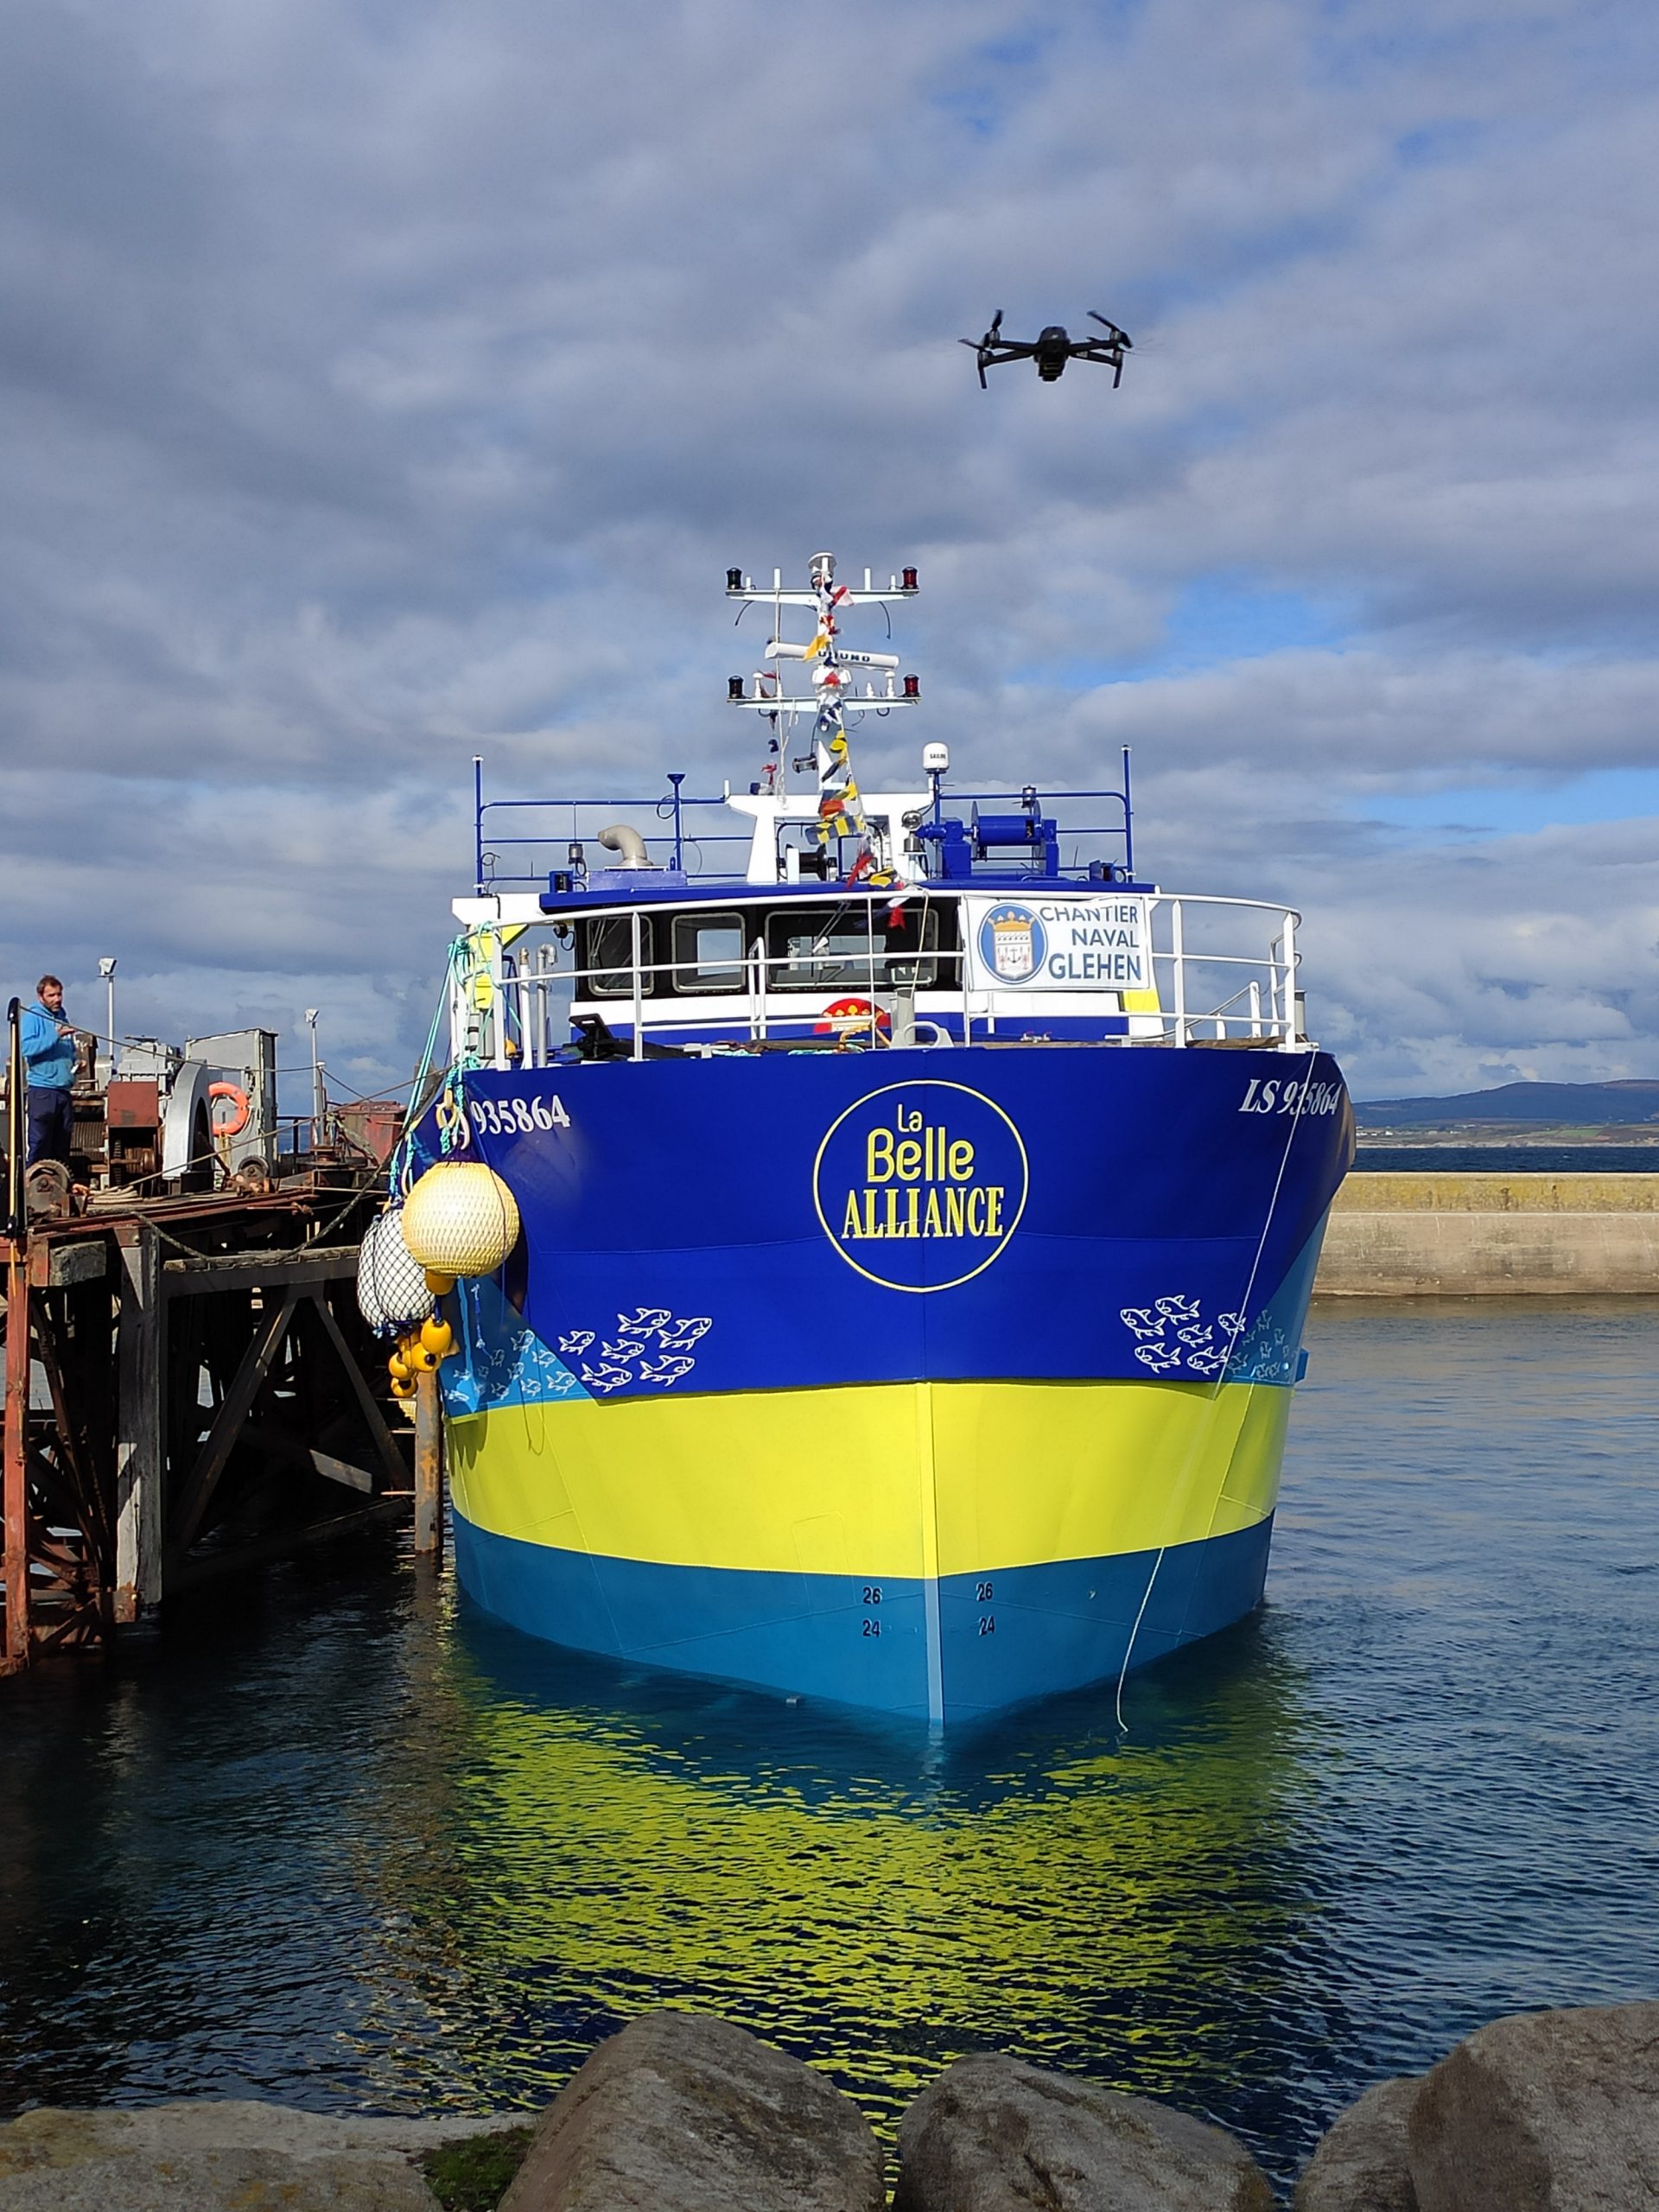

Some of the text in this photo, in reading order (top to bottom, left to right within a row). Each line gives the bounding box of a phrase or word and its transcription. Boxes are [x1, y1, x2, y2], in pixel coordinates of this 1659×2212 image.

[817, 651, 871, 663] UUNO
[1039, 905, 1138, 925] CHANTIER
[1071, 928, 1140, 948] NAVAL
[1048, 953, 1141, 981] GLEHEN
[1238, 1078, 1281, 1114] LS
[470, 1094, 570, 1135] 935864
[897, 1103, 923, 1133] La
[867, 1127, 975, 1182] Belle
[841, 1187, 1005, 1239] ALLIANCE
[863, 1586, 882, 1605] 26
[976, 1581, 994, 1602] 26
[862, 1618, 881, 1637] 24
[978, 1615, 995, 1637] 24
